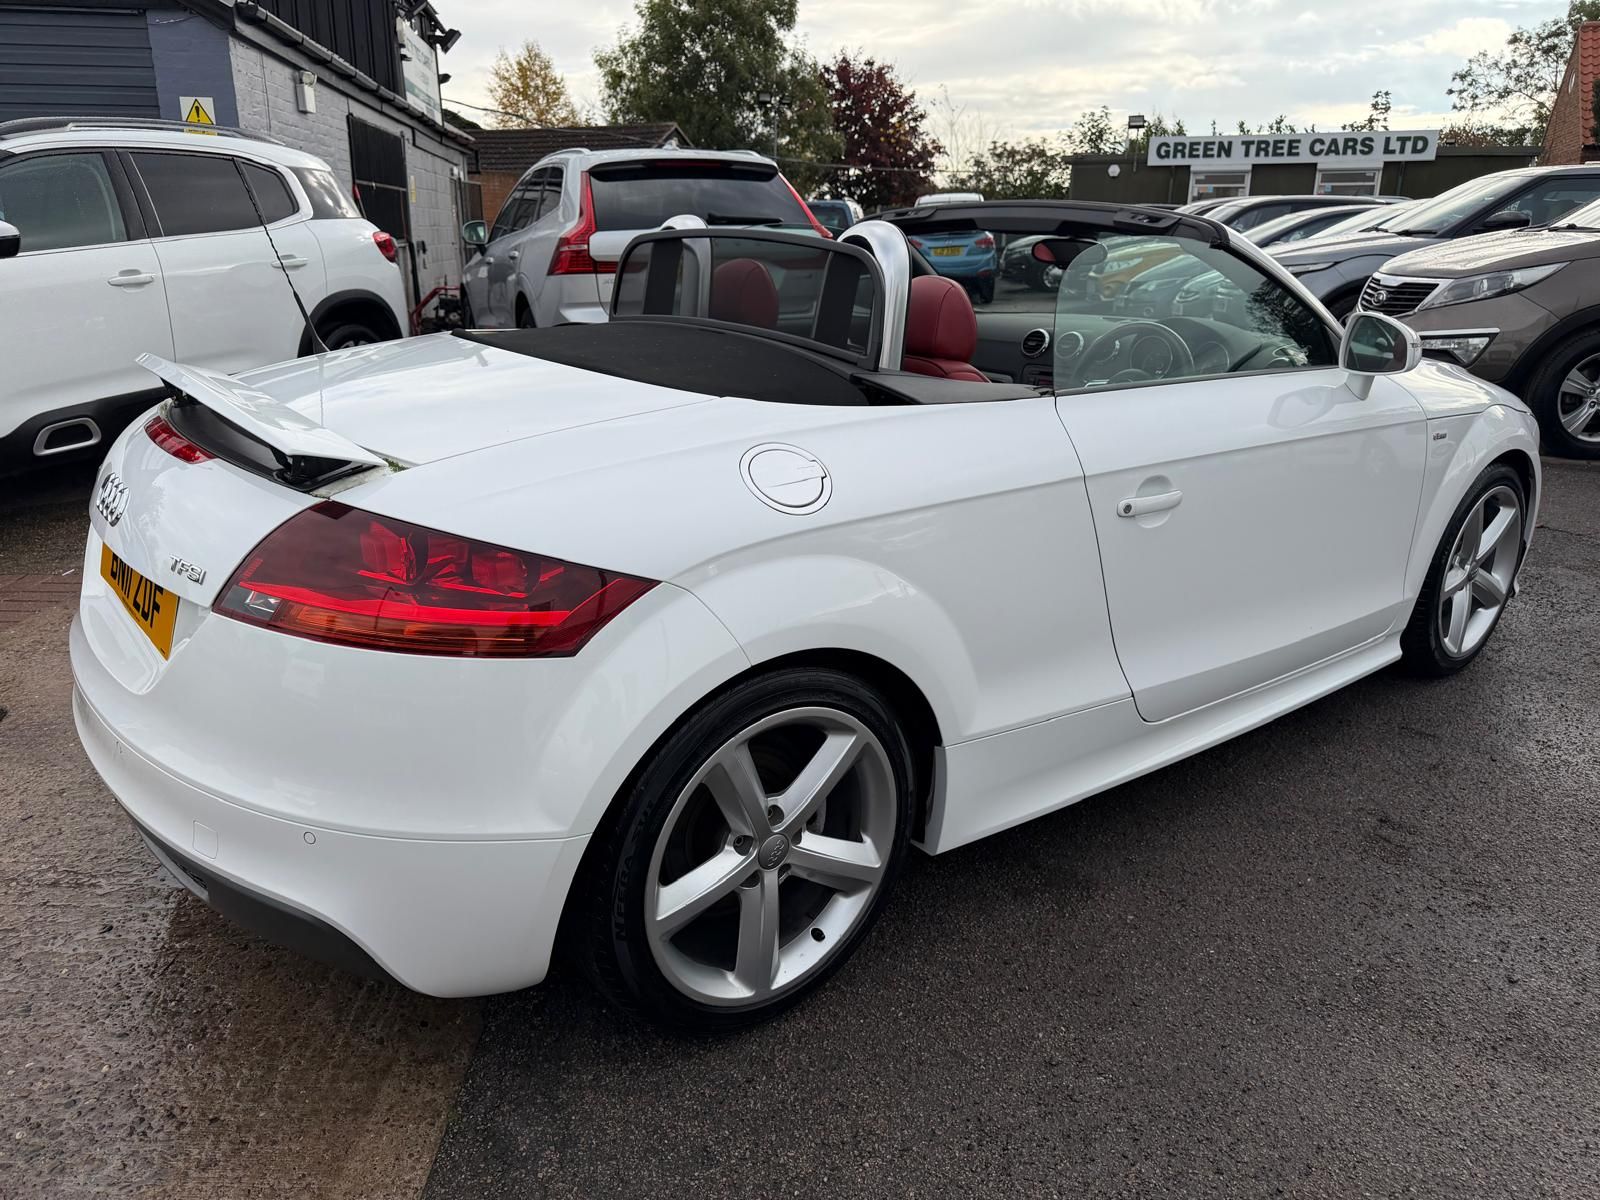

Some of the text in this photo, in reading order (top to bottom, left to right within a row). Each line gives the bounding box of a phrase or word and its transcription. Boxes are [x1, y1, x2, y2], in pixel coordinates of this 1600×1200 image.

[1155, 135, 1429, 160] GREEN TREE CARS LTD
[169, 554, 207, 585] TFSI
[133, 574, 164, 629] ZDF
